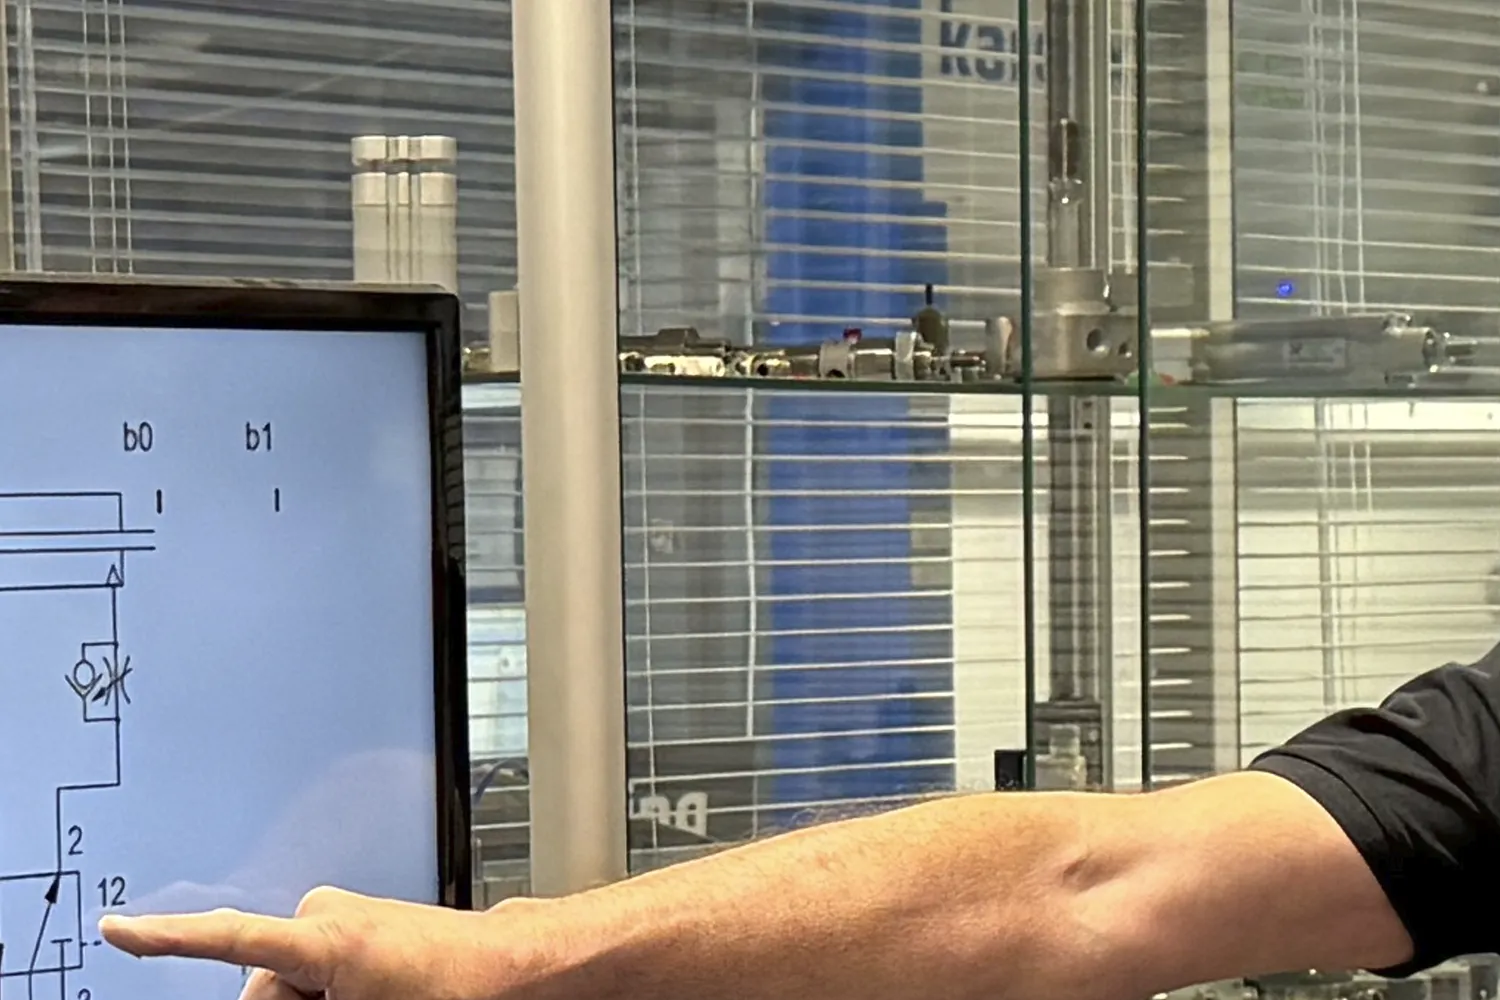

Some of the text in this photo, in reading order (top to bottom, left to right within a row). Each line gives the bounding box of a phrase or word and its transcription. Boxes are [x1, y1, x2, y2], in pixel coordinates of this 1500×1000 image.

[123, 422, 153, 452] b0
[245, 422, 272, 452] b1
[67, 825, 83, 856] 2
[97, 876, 126, 908] 12
